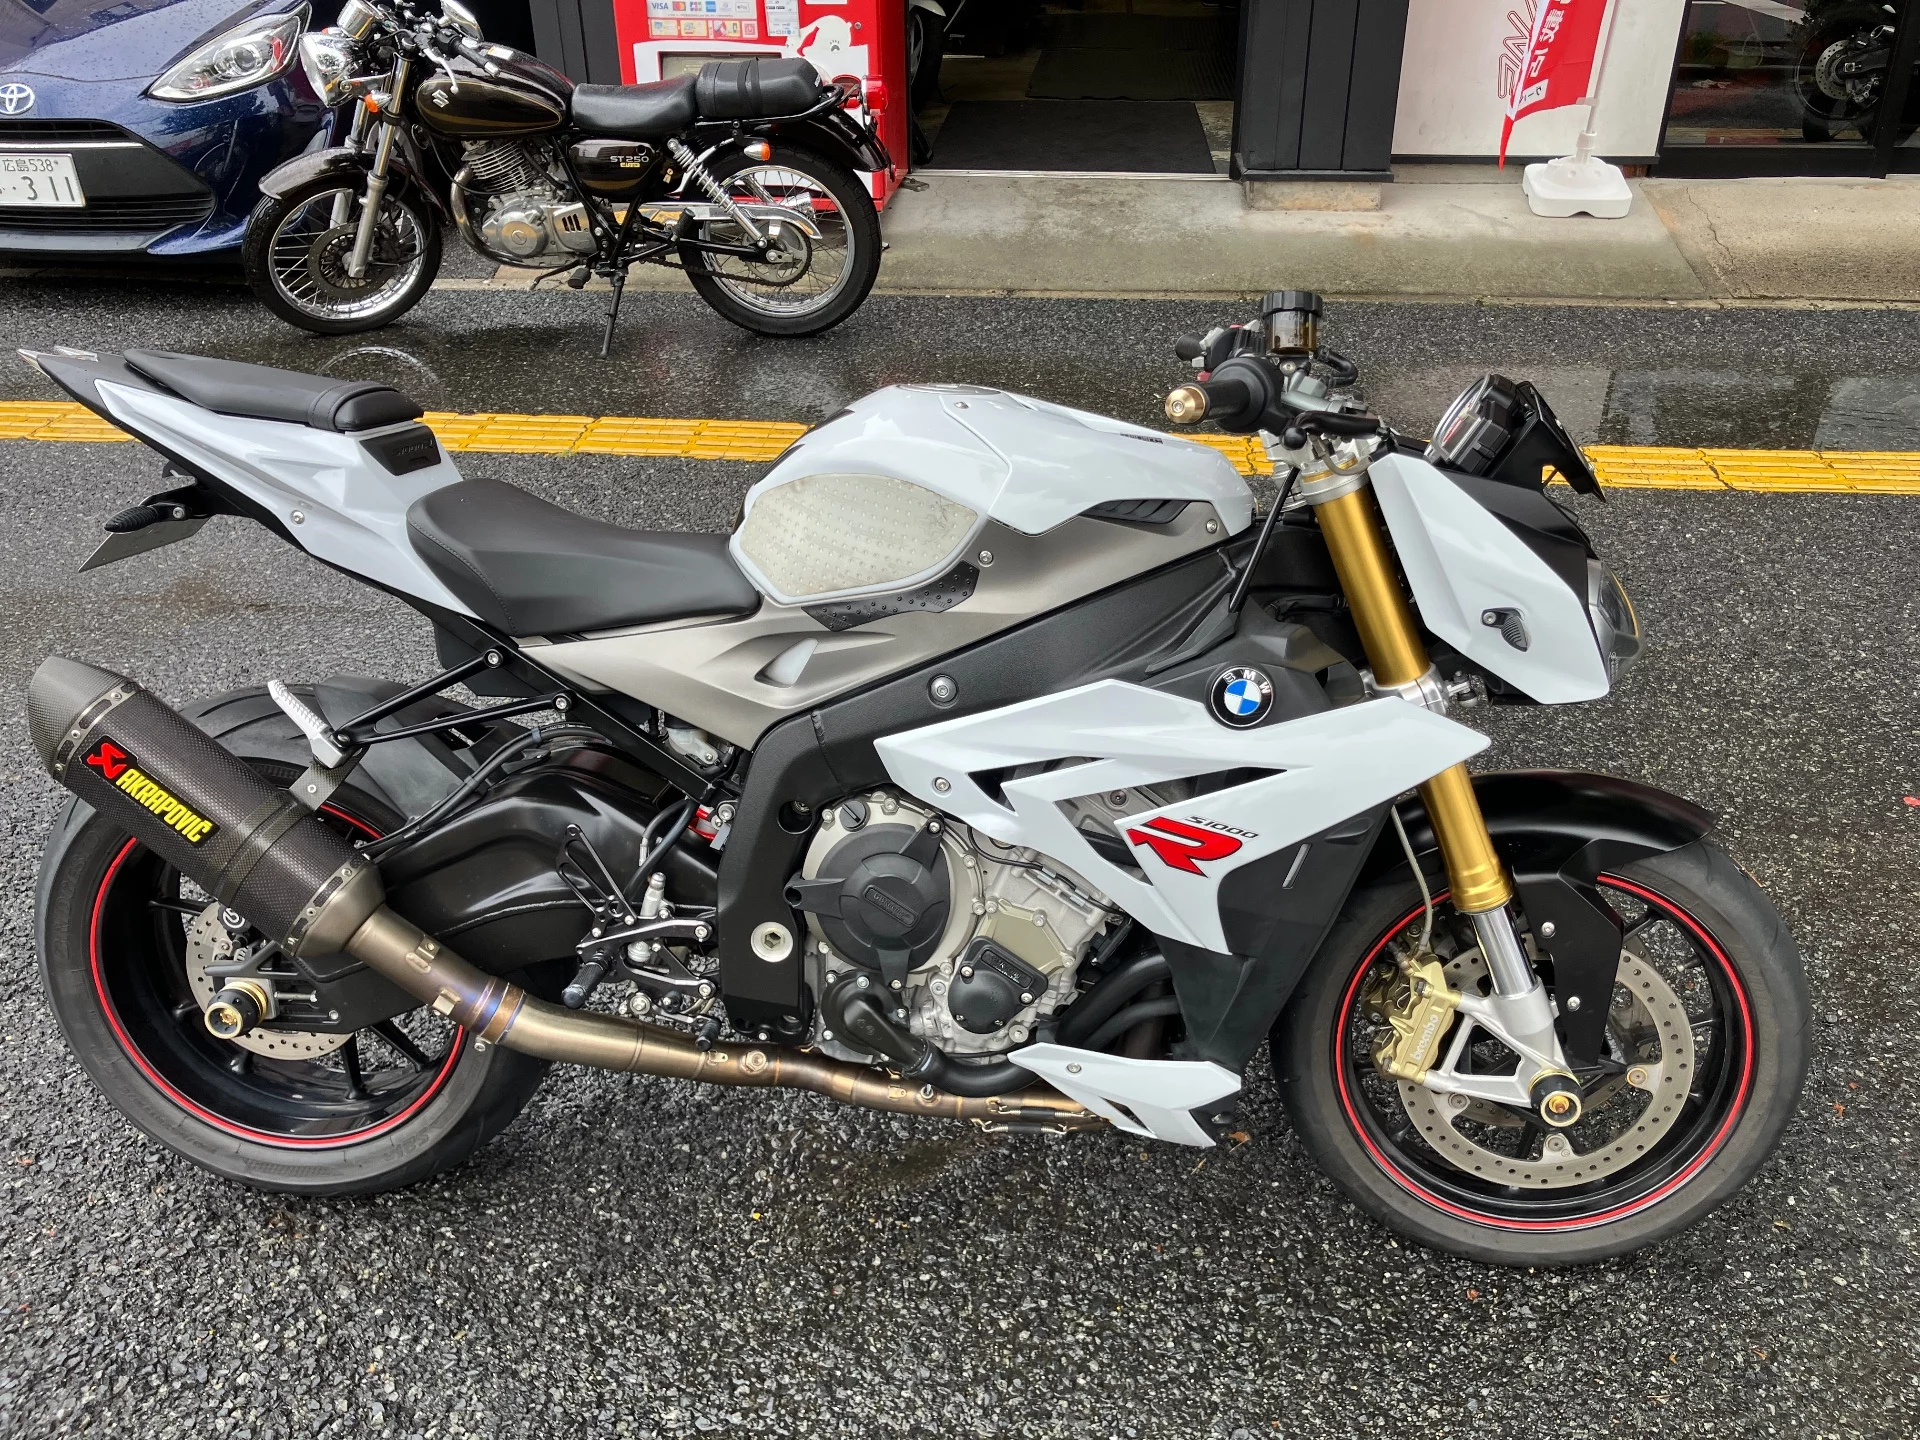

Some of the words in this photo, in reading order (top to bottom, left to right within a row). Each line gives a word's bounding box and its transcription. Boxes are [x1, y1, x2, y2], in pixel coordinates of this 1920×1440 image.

[651, 2, 669, 10] VISA
[1223, 669, 1271, 694] BMW
[1185, 816, 1259, 839] S1000
[1410, 1014, 1439, 1061] brembo
